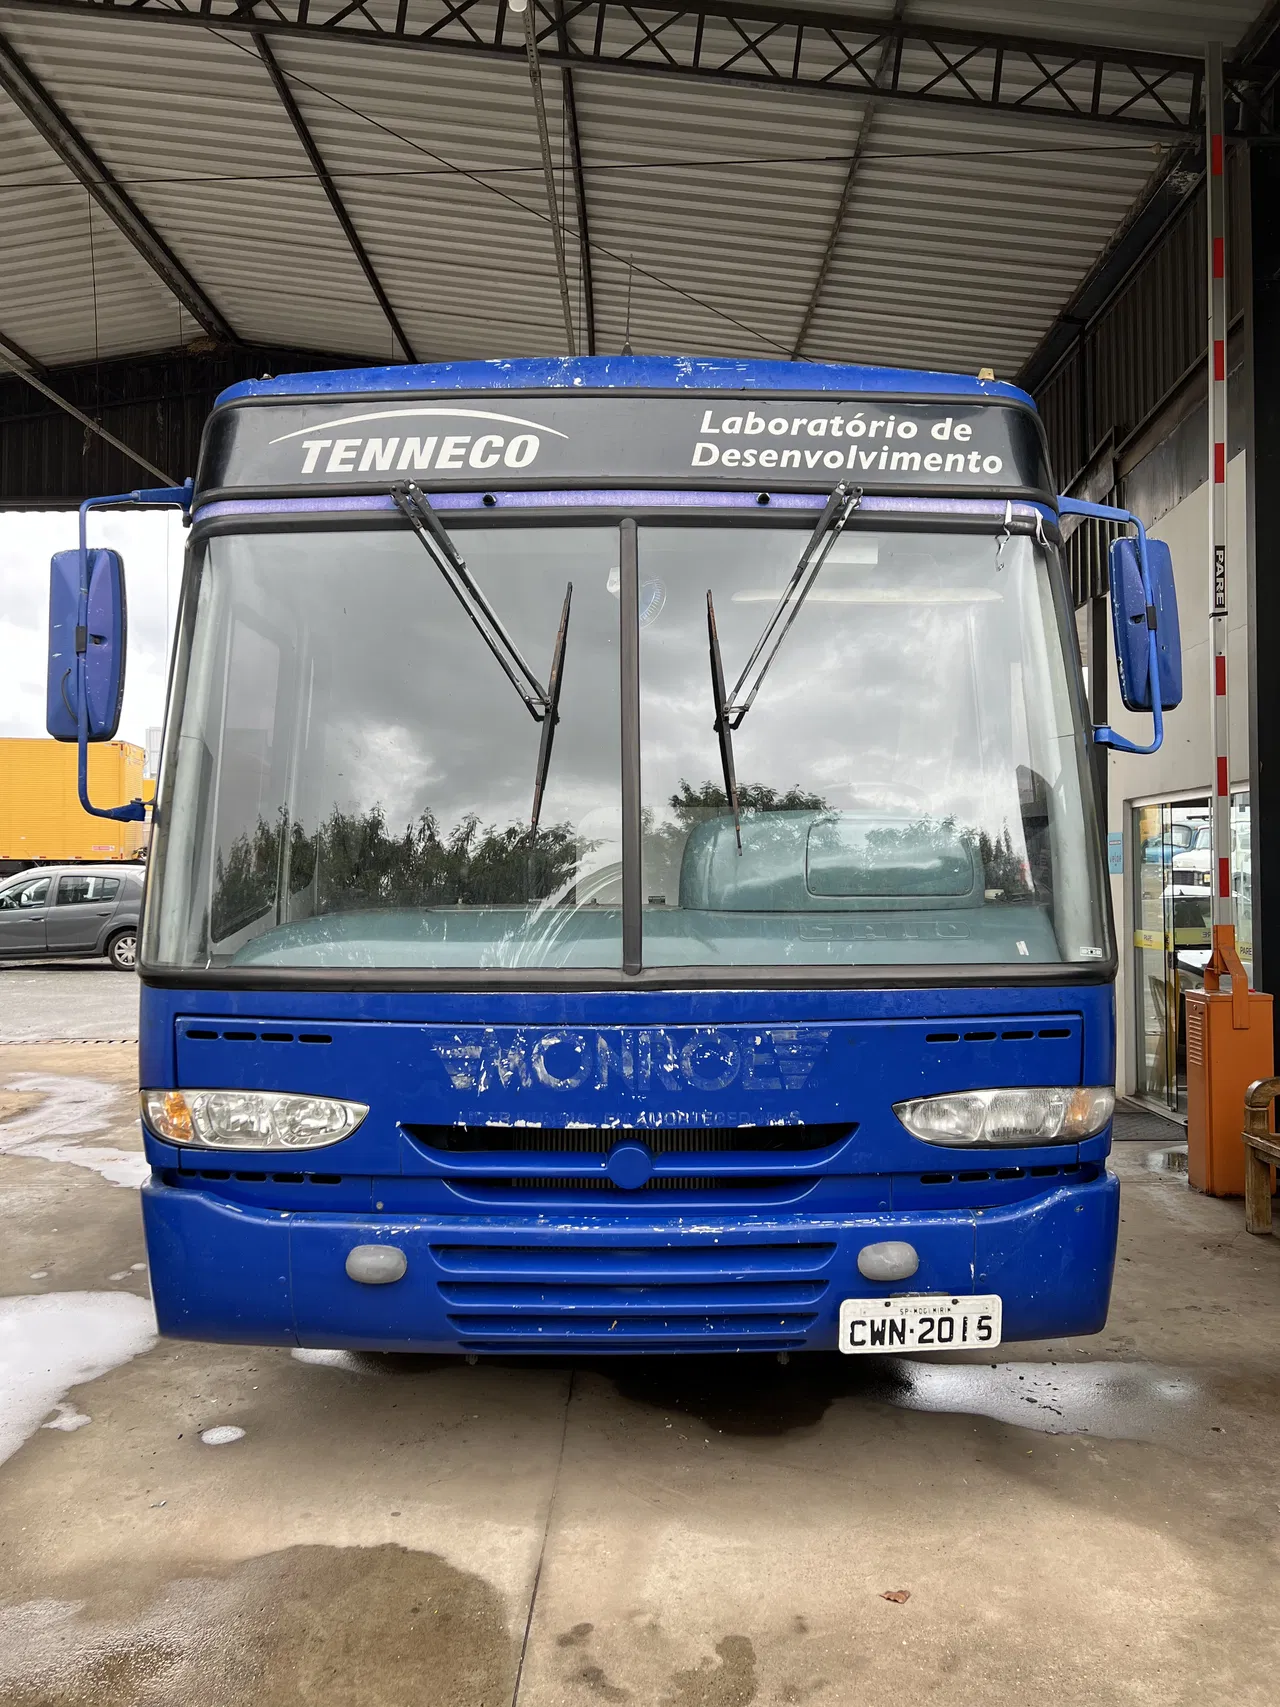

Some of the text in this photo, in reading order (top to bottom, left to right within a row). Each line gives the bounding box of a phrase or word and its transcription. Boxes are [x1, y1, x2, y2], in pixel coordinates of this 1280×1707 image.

[700, 410, 973, 442] Laboratório de
[301, 434, 540, 474] TENNECO
[691, 442, 1003, 475] Desenvolvimento
[1215, 550, 1225, 605] PARE
[476, 1029, 784, 1091] MONROE
